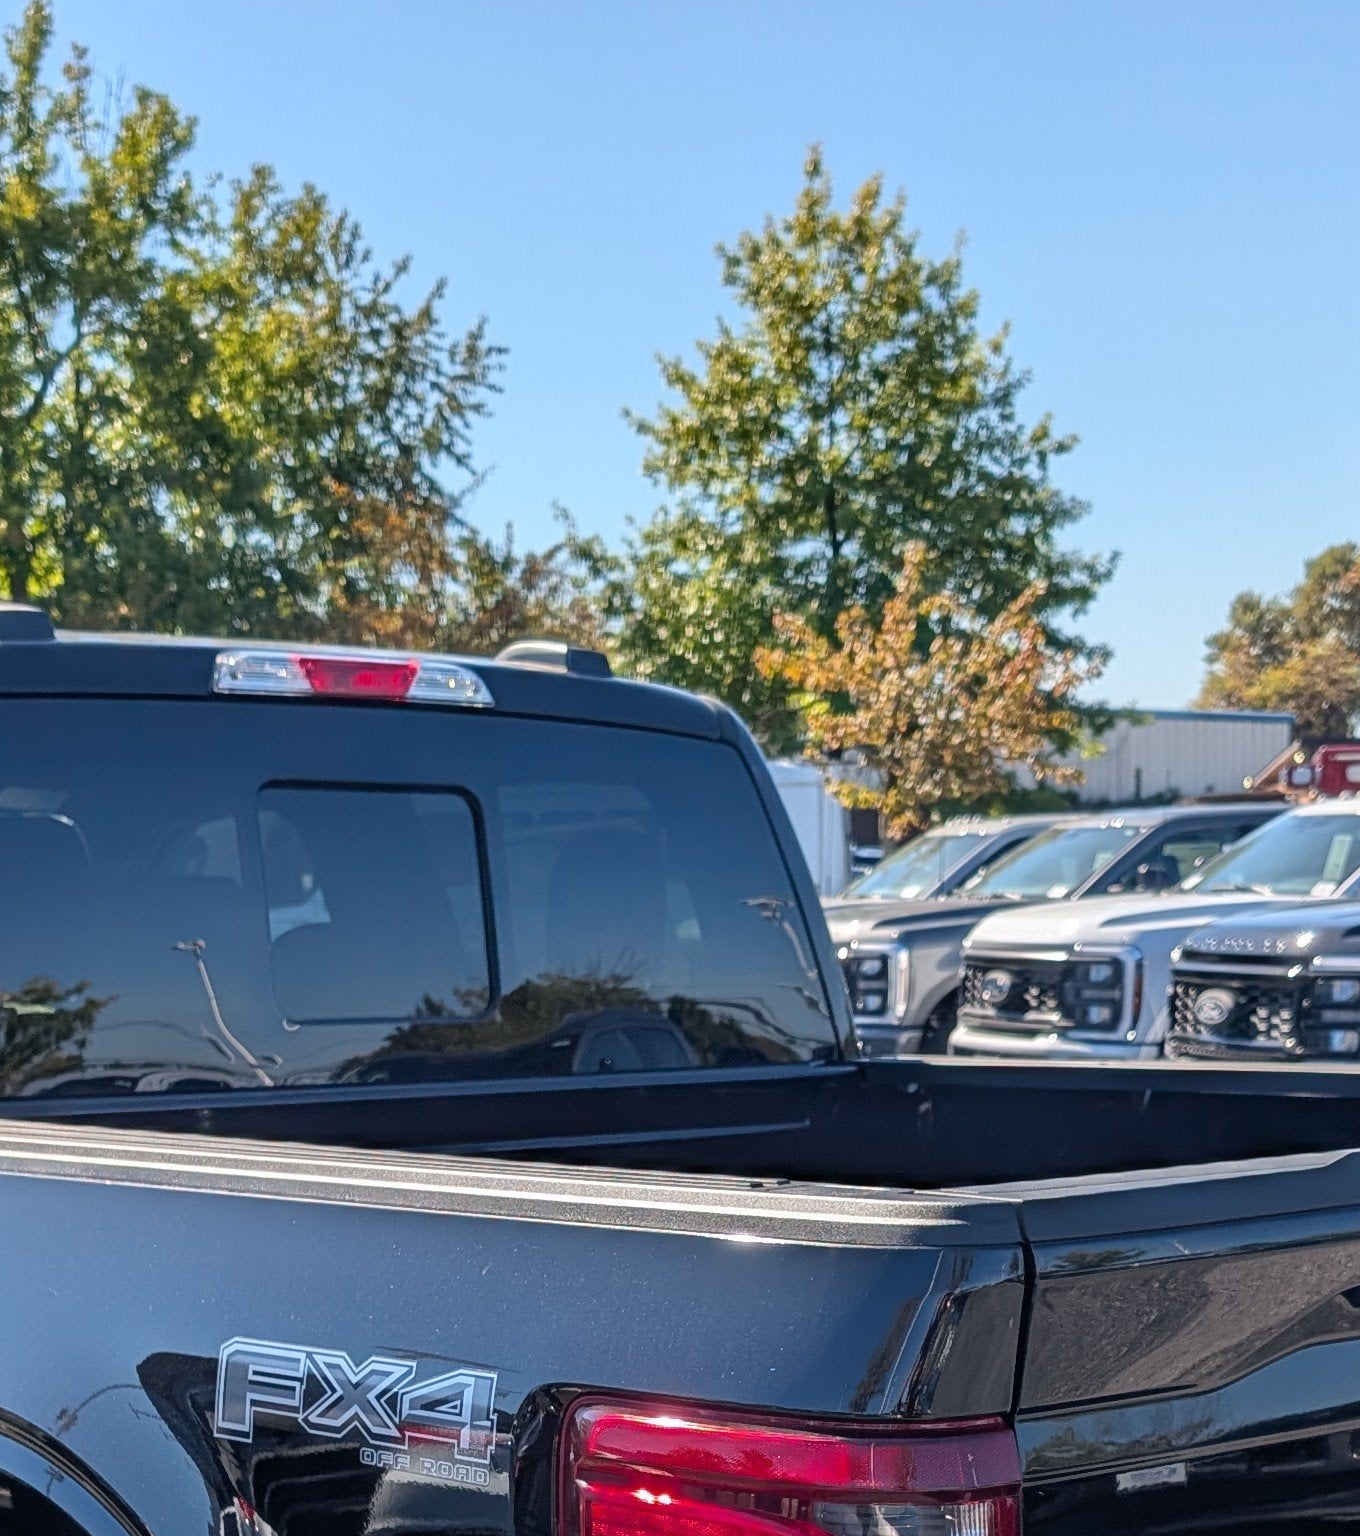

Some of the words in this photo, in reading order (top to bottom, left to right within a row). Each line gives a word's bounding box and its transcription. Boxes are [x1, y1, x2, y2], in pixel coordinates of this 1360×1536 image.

[213, 1337, 498, 1463] FX4
[359, 1447, 411, 1471] OFF
[419, 1456, 490, 1486] ROAD
